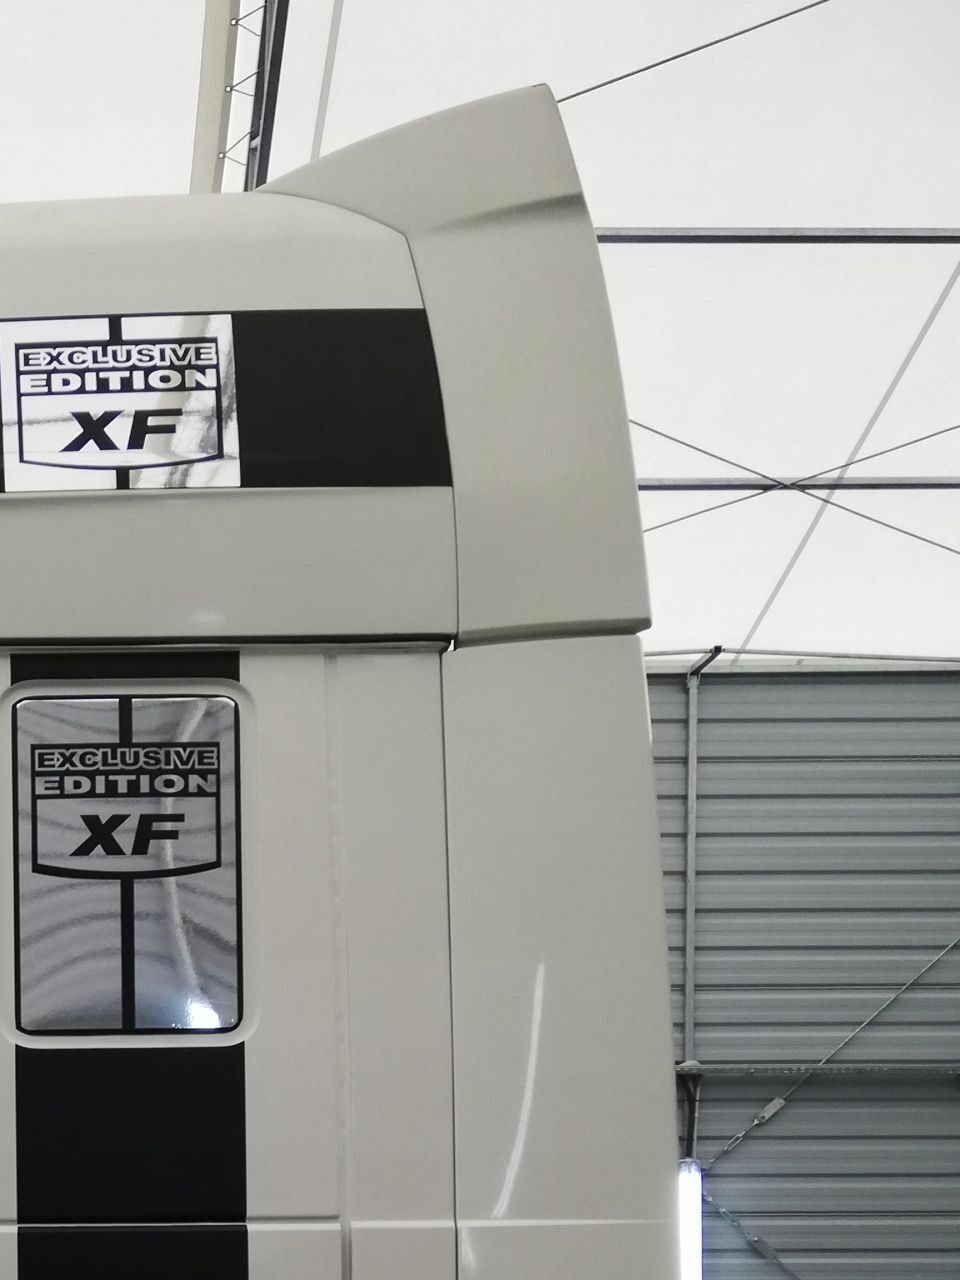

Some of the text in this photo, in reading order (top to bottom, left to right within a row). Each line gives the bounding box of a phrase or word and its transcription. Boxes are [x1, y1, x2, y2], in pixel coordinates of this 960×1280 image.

[20, 344, 217, 370] EXCLUSIVE
[20, 369, 217, 393] EDITION
[59, 408, 183, 452] XF
[35, 748, 218, 771] EXCLUSIVE
[35, 774, 217, 795] EDITION
[69, 813, 185, 856] XF
